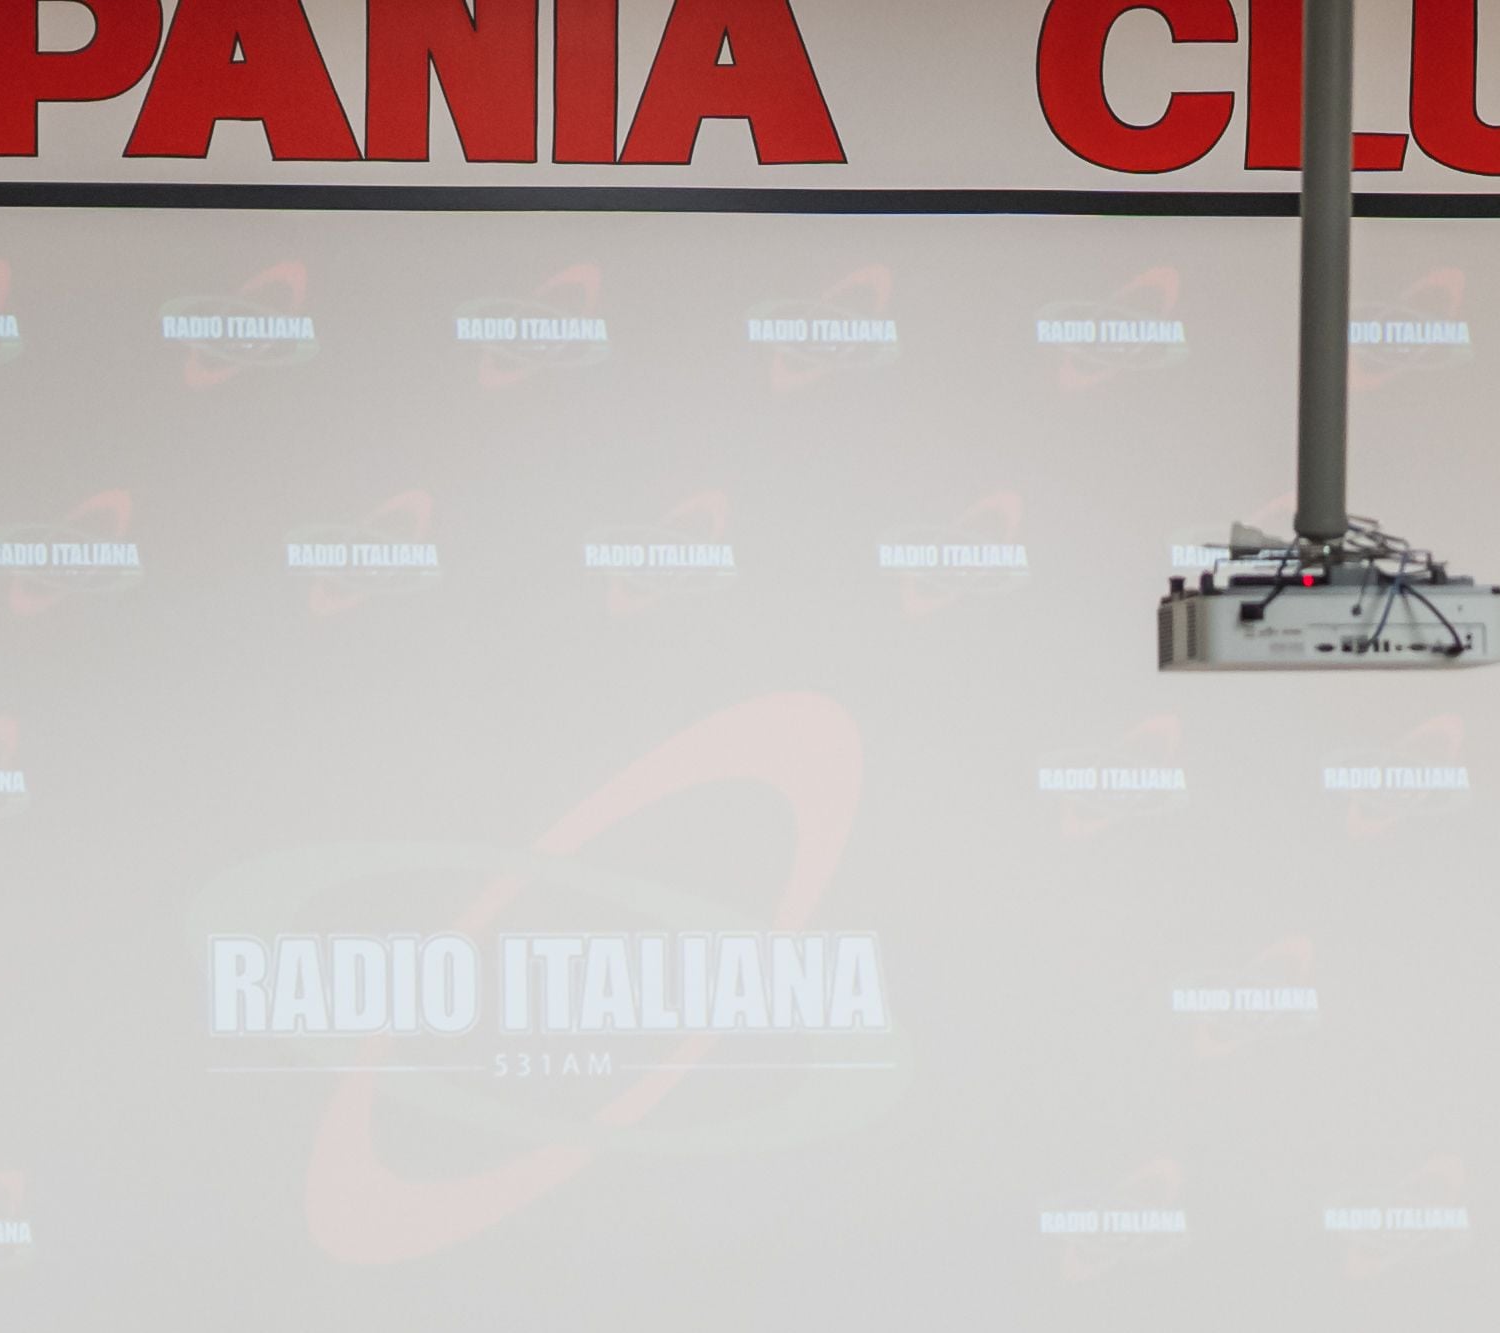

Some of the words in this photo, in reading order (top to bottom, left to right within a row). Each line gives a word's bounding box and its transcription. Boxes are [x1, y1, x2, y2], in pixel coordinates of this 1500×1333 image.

[160, 316, 221, 340] RADIO
[228, 316, 315, 340] ITALIANA
[454, 317, 514, 341] RADIO
[521, 317, 607, 341] ITALIANA
[745, 318, 805, 343] RADIO
[811, 318, 897, 343] ITALIANA
[1036, 319, 1094, 344] RADIO
[1101, 319, 1184, 344] ITALIANA
[1350, 321, 1380, 346] DIO
[1386, 320, 1470, 346] ITALIANA
[52, 541, 140, 567] ITALIANA
[286, 543, 346, 568] RADIO
[352, 543, 438, 568] ITALIANA
[583, 543, 642, 568] RADIO
[649, 543, 734, 568] ITALIANA
[878, 543, 937, 568] RADIO
[943, 543, 1027, 568] ITALIANA
[1038, 767, 1096, 791] RADIO
[1102, 767, 1185, 791] ITALIANA
[1322, 766, 1380, 791] RADIO
[1386, 766, 1469, 791] ITALIANA
[206, 933, 475, 1037] RADIO
[504, 932, 889, 1033] ITALIANA
[1170, 987, 1228, 1013] RADIO
[1235, 987, 1318, 1013] ITALIANA
